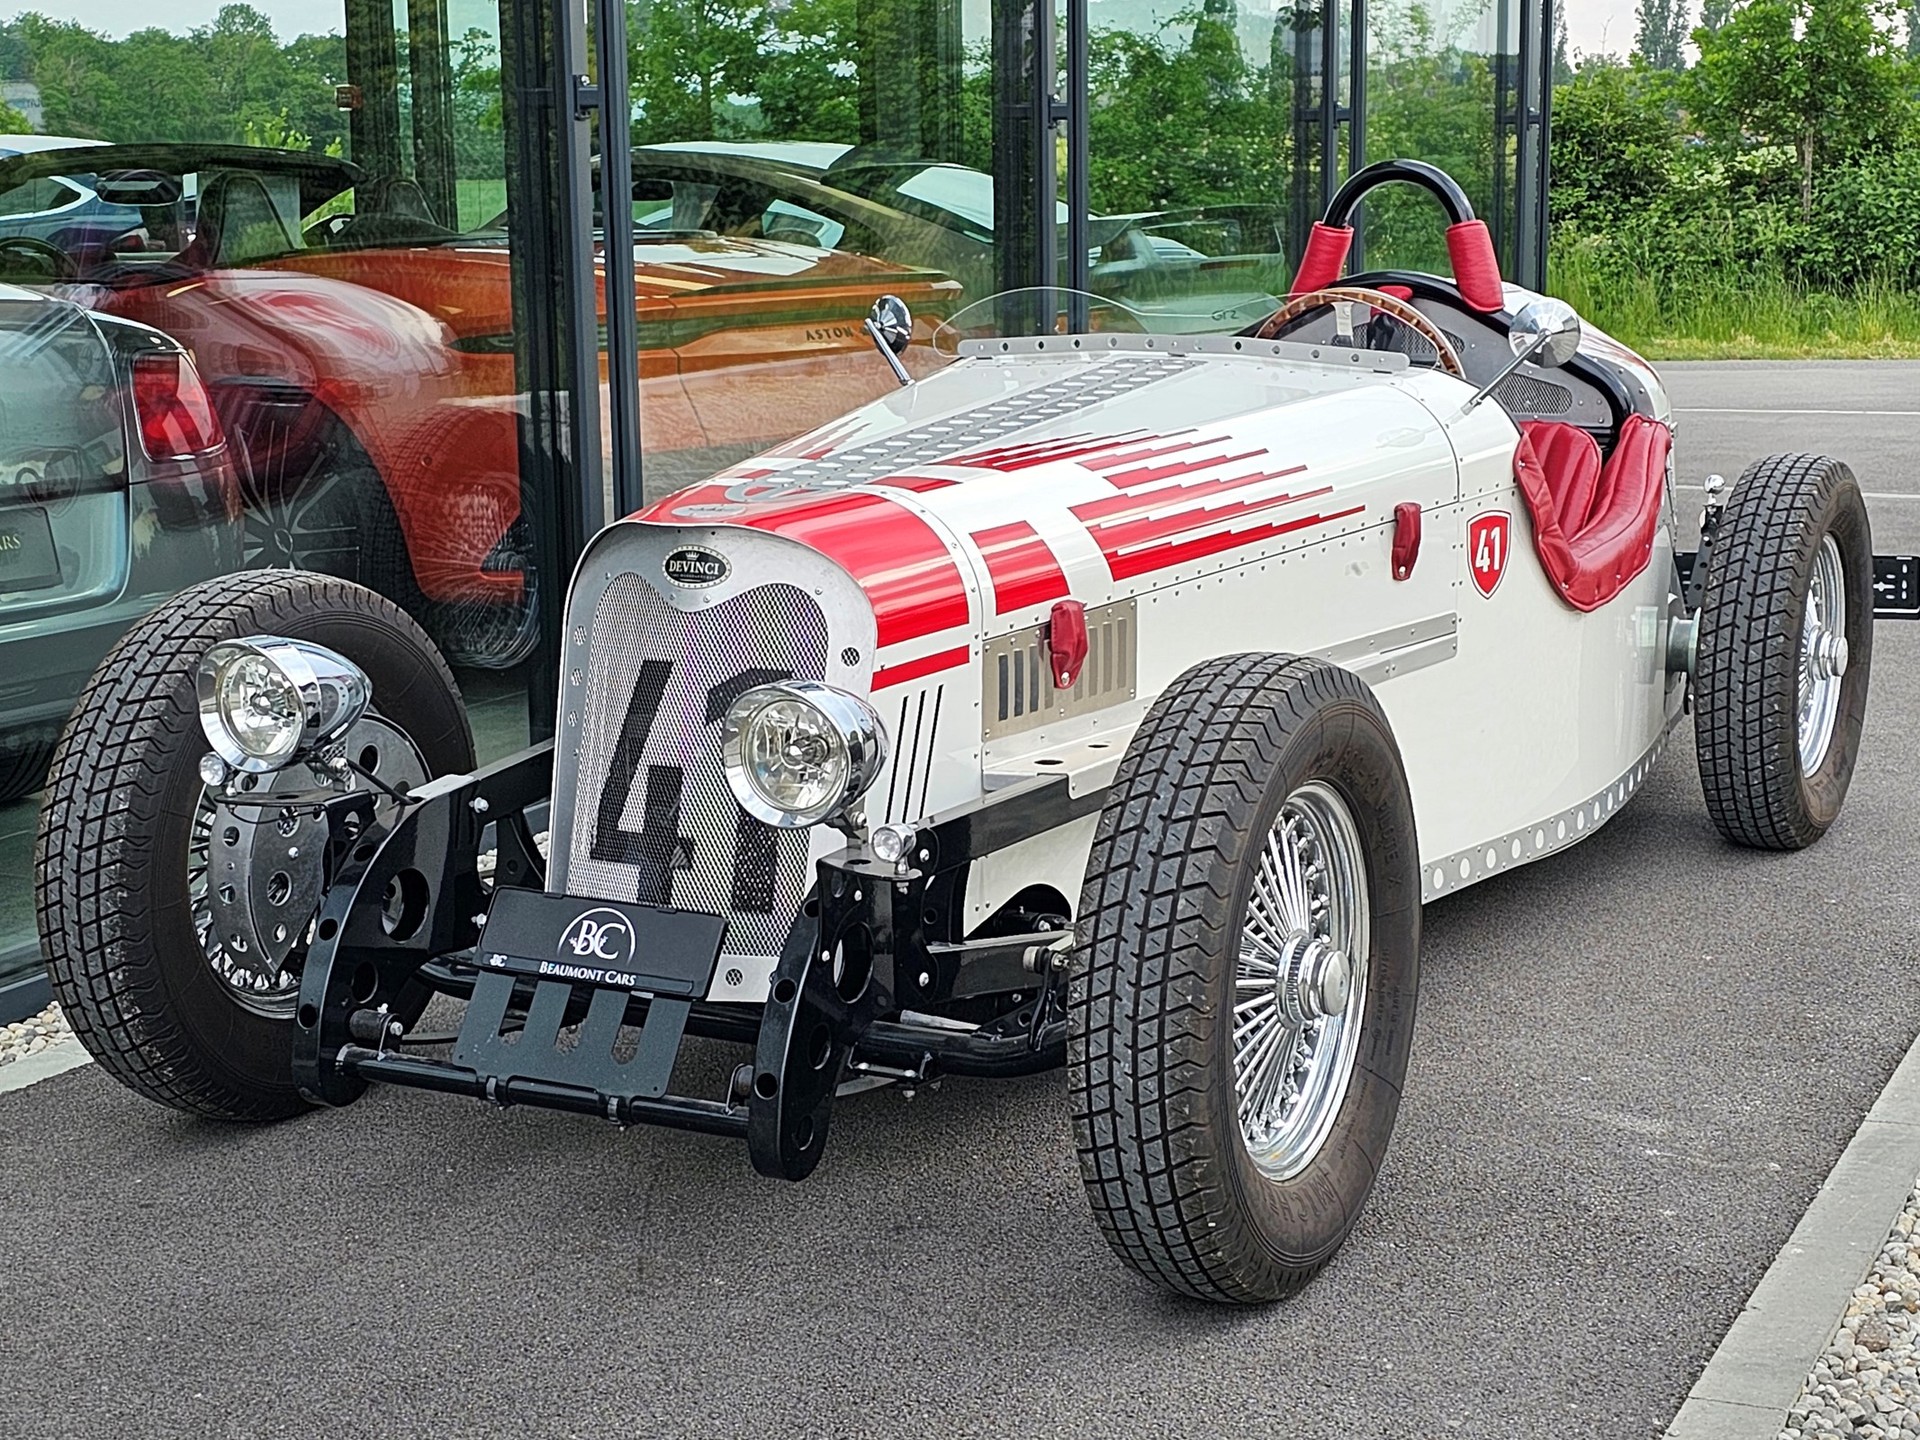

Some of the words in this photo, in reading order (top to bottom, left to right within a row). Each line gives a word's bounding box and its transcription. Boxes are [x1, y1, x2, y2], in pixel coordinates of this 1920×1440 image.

[805, 326, 854, 341] ASTON
[0, 533, 22, 551] RS
[1474, 526, 1501, 573] 41
[668, 560, 720, 575] DEVINCI
[569, 919, 627, 960] BC
[539, 961, 604, 982] BEAUMONT
[605, 970, 637, 986] CARS
